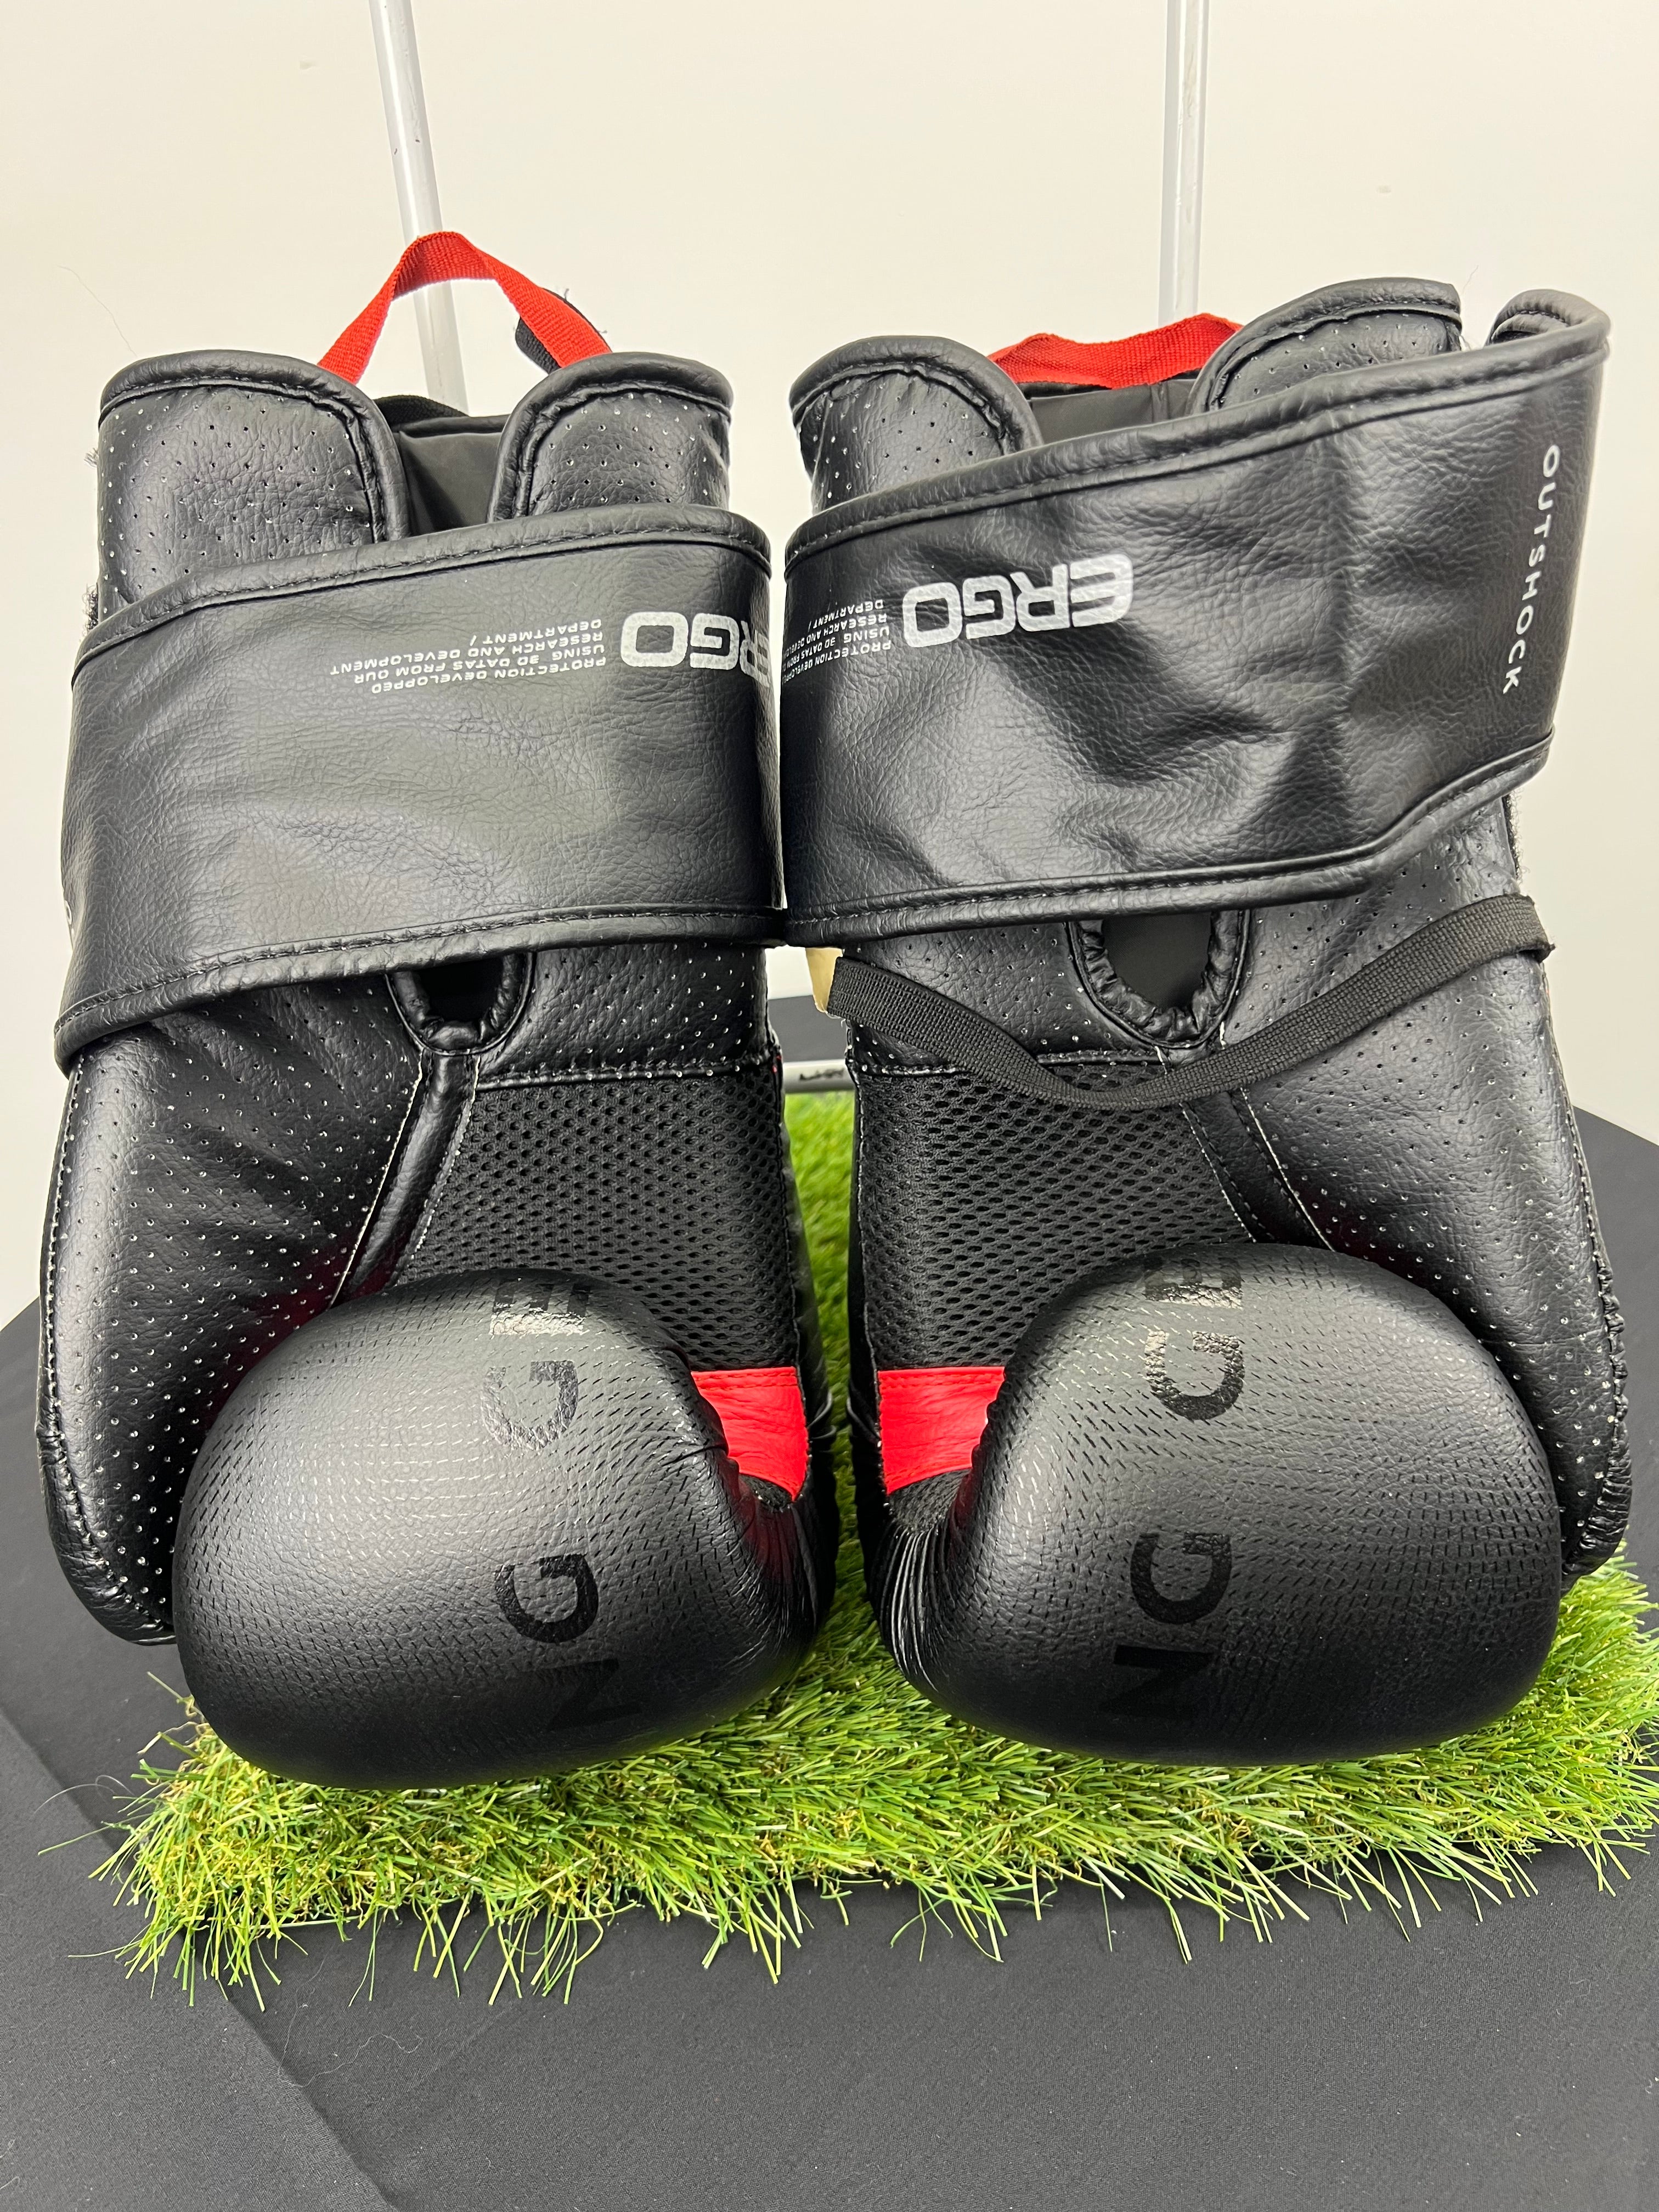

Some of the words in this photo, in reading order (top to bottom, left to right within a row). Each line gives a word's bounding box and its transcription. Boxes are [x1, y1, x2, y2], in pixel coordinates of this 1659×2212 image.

[1503, 444, 1560, 694] OUTSHOCK
[902, 554, 1133, 648] ERGO
[813, 599, 883, 629] DEPARTMENT
[483, 619, 602, 645] DEPARTMENT
[823, 613, 887, 636] RESEARCH
[843, 625, 889, 643] USING
[512, 632, 603, 653] RESEARCH
[806, 630, 821, 644] AND
[824, 637, 836, 648] 3D
[467, 646, 505, 658] AND
[517, 654, 539, 665] 3D
[552, 645, 605, 661] USING
[801, 642, 822, 659] DATAS
[815, 640, 891, 666] PROTECTION
[330, 648, 460, 675] DEVELOPMENT
[396, 663, 445, 676] FROM
[453, 657, 510, 670] DATAS
[494, 656, 606, 678] PROTECTION
[354, 669, 388, 684] OUR
[371, 669, 487, 694] DEVELOPPED
